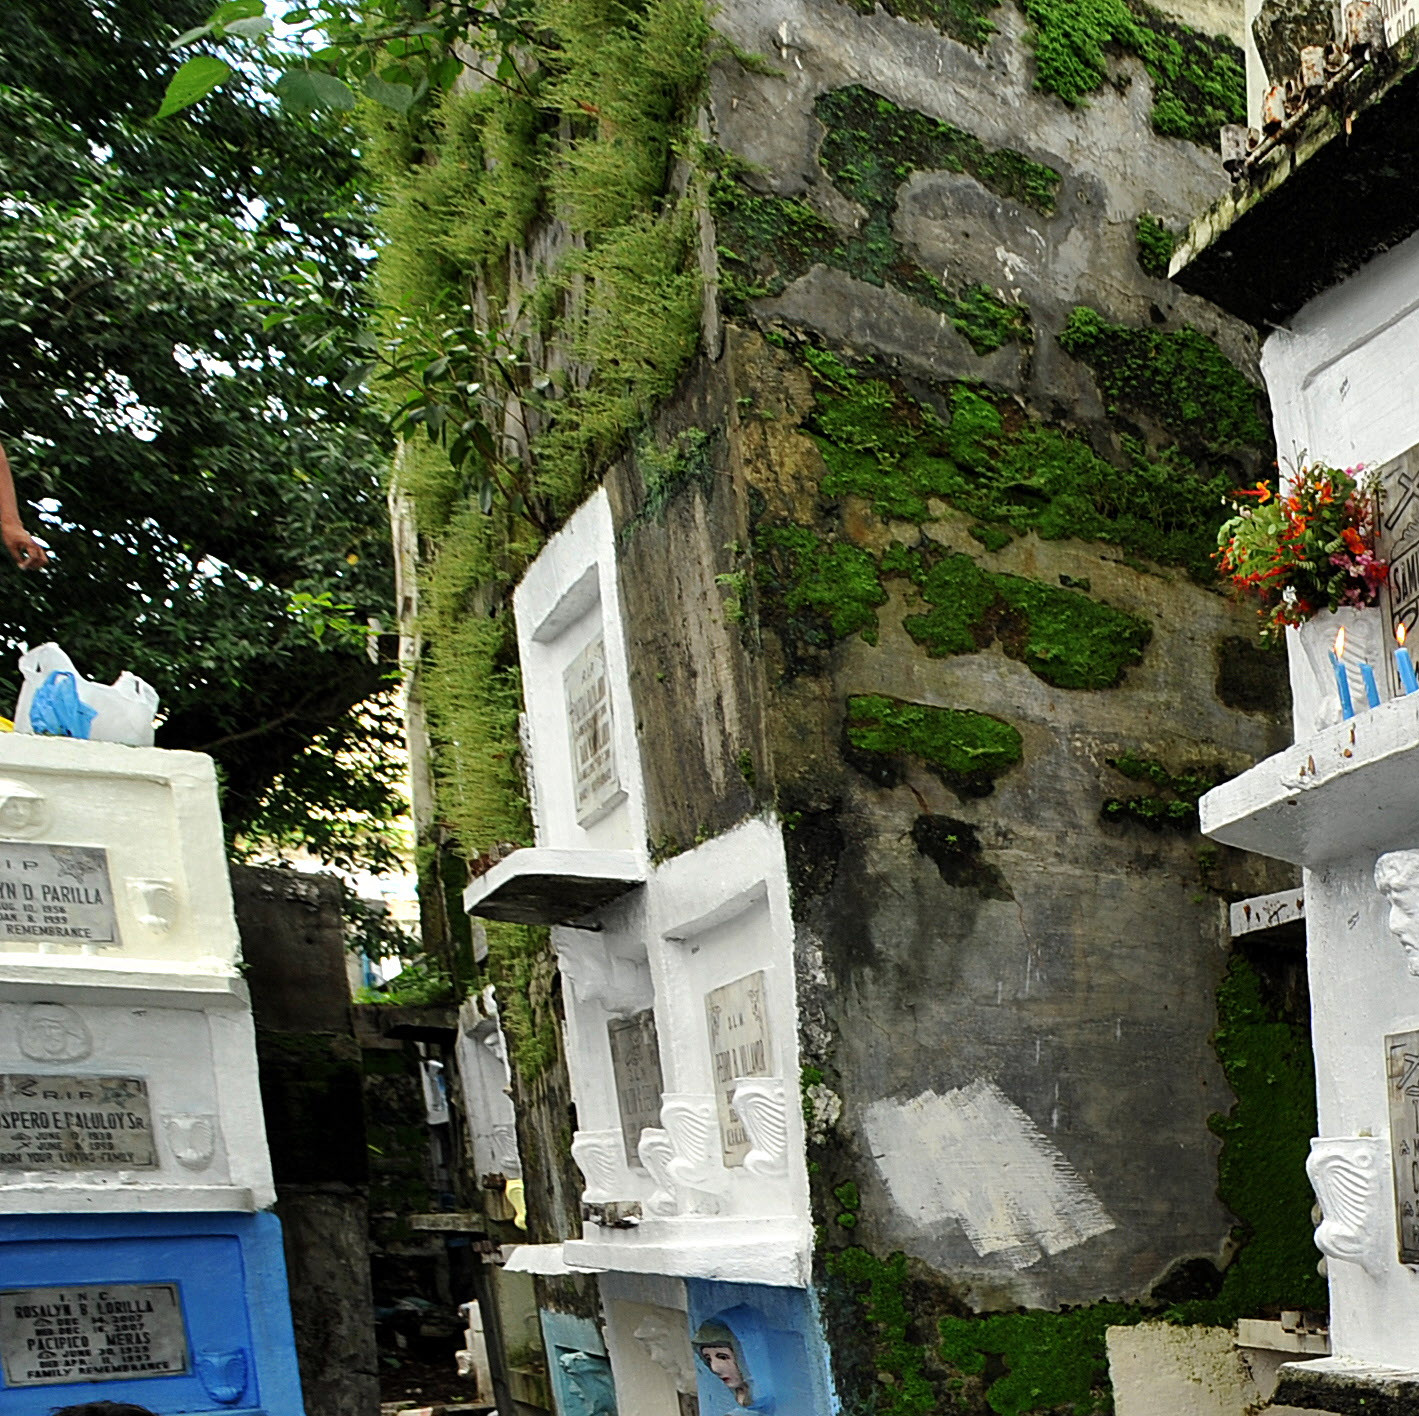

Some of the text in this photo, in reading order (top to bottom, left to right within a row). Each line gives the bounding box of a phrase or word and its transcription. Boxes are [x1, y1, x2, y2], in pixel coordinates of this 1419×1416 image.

[41, 884, 104, 905] PARILLA
[6, 924, 92, 938] REMEMBRANCE
[97, 1300, 154, 1315] LORILLA
[27, 1336, 89, 1351] PACIFICO
[27, 1361, 169, 1379] FAMILY REMEMBRANCE
